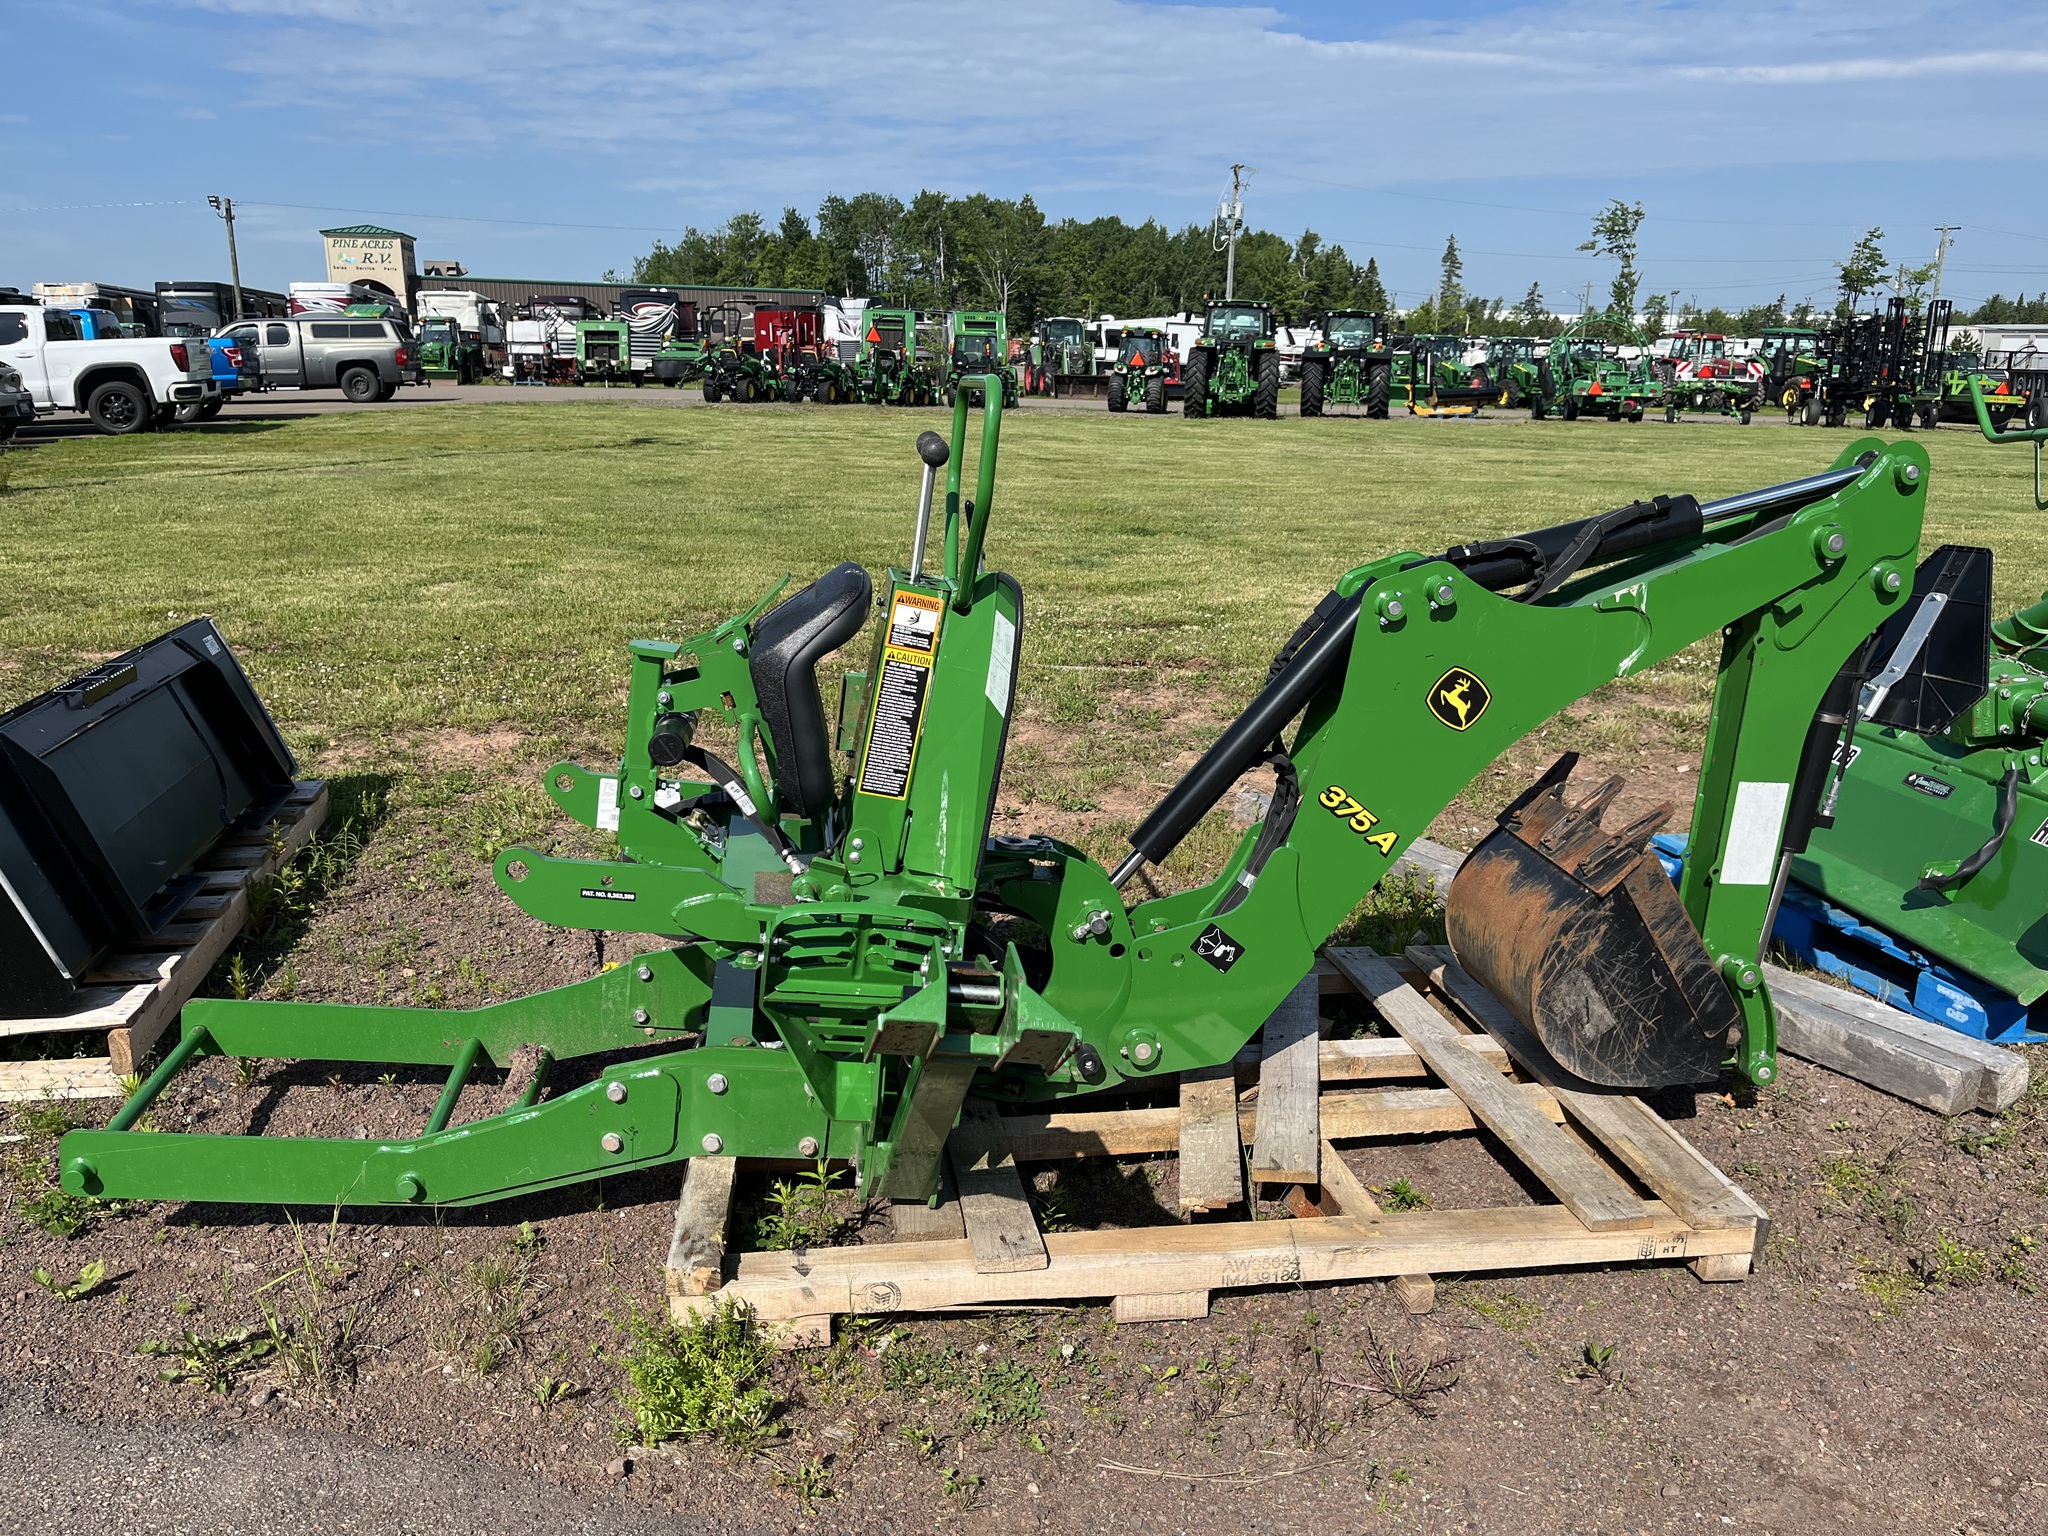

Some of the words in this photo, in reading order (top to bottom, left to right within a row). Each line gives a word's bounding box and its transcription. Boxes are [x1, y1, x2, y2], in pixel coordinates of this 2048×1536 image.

[332, 239, 358, 249] PINE
[360, 240, 394, 250] ACRES
[361, 252, 392, 264] R.V.
[905, 595, 940, 611] WARNING
[896, 651, 932, 666] CAUTION
[1663, 1246, 1677, 1254] HT
